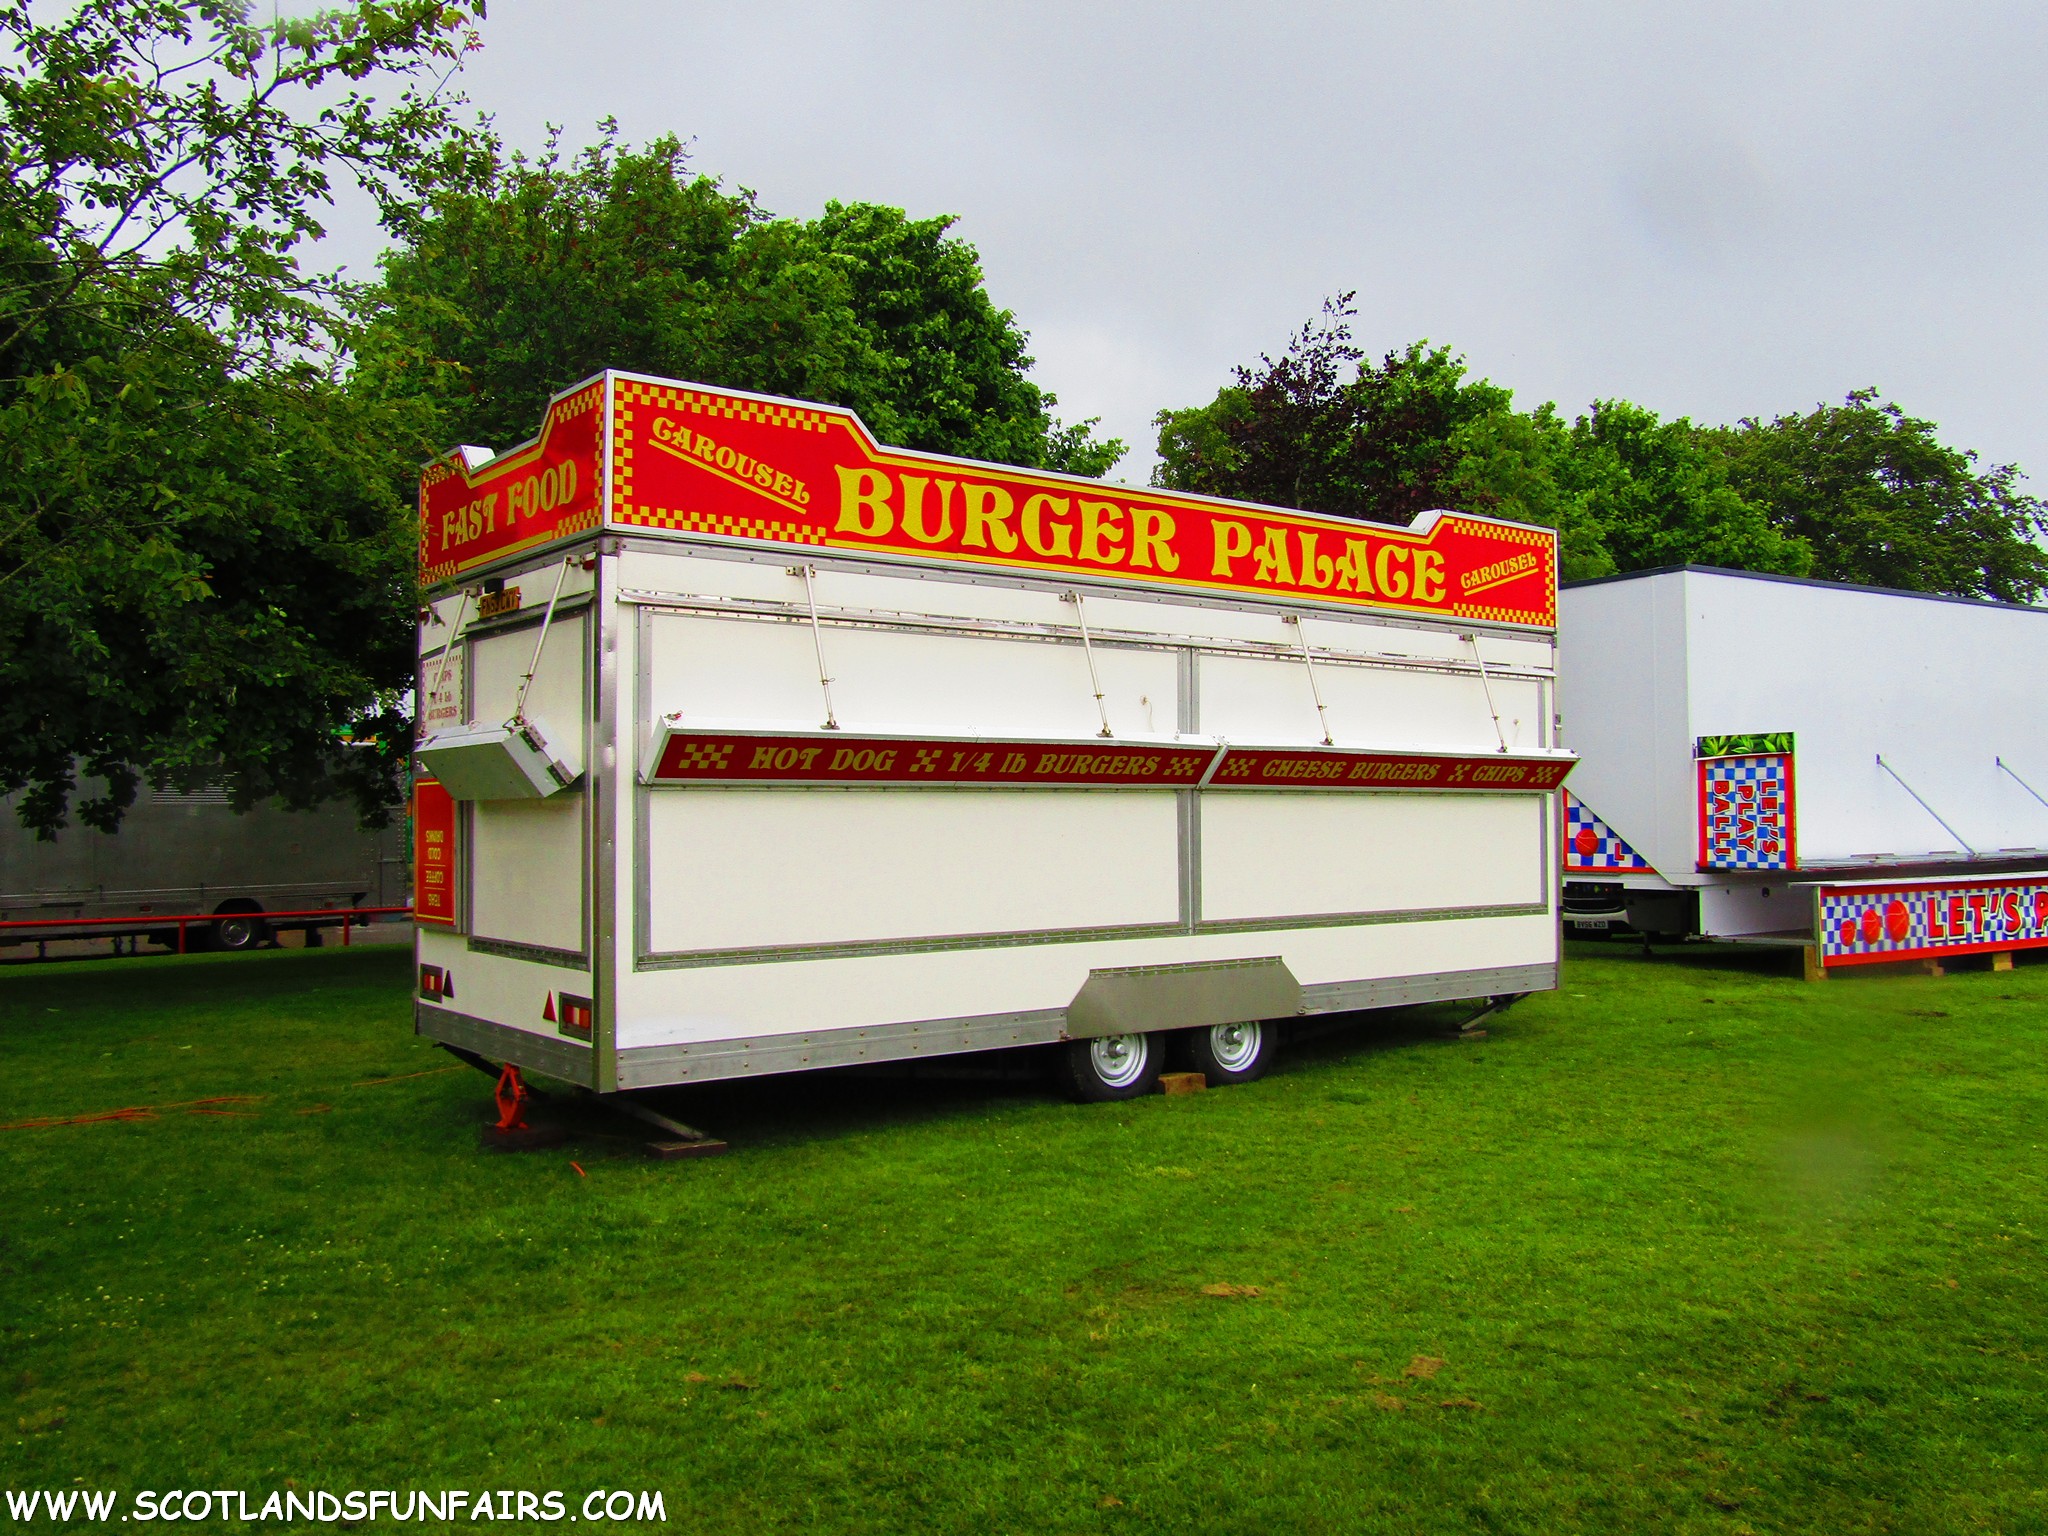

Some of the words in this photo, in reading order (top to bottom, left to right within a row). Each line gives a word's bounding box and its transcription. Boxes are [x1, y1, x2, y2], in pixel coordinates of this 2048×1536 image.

[652, 417, 810, 505] CAROUSEL
[441, 492, 498, 551] FAST
[507, 459, 577, 526] FOOD
[834, 464, 1179, 573] BURGER
[1211, 518, 1446, 603] PALACE
[1461, 551, 1537, 589] CAROUSEL
[748, 746, 823, 771] HOT
[829, 748, 898, 772] DOG
[948, 751, 993, 773] 1/4
[1000, 752, 1026, 774] lb
[1034, 753, 1163, 776] BURGERS
[1262, 759, 1345, 780] CHEESE
[1348, 762, 1441, 782] BURGERS
[1472, 765, 1528, 783] CHIPS
[1713, 780, 1731, 856] BALL!
[1737, 784, 1755, 853] PLAY
[1761, 780, 1779, 855] LET'S
[1926, 890, 2022, 941] LET'S
